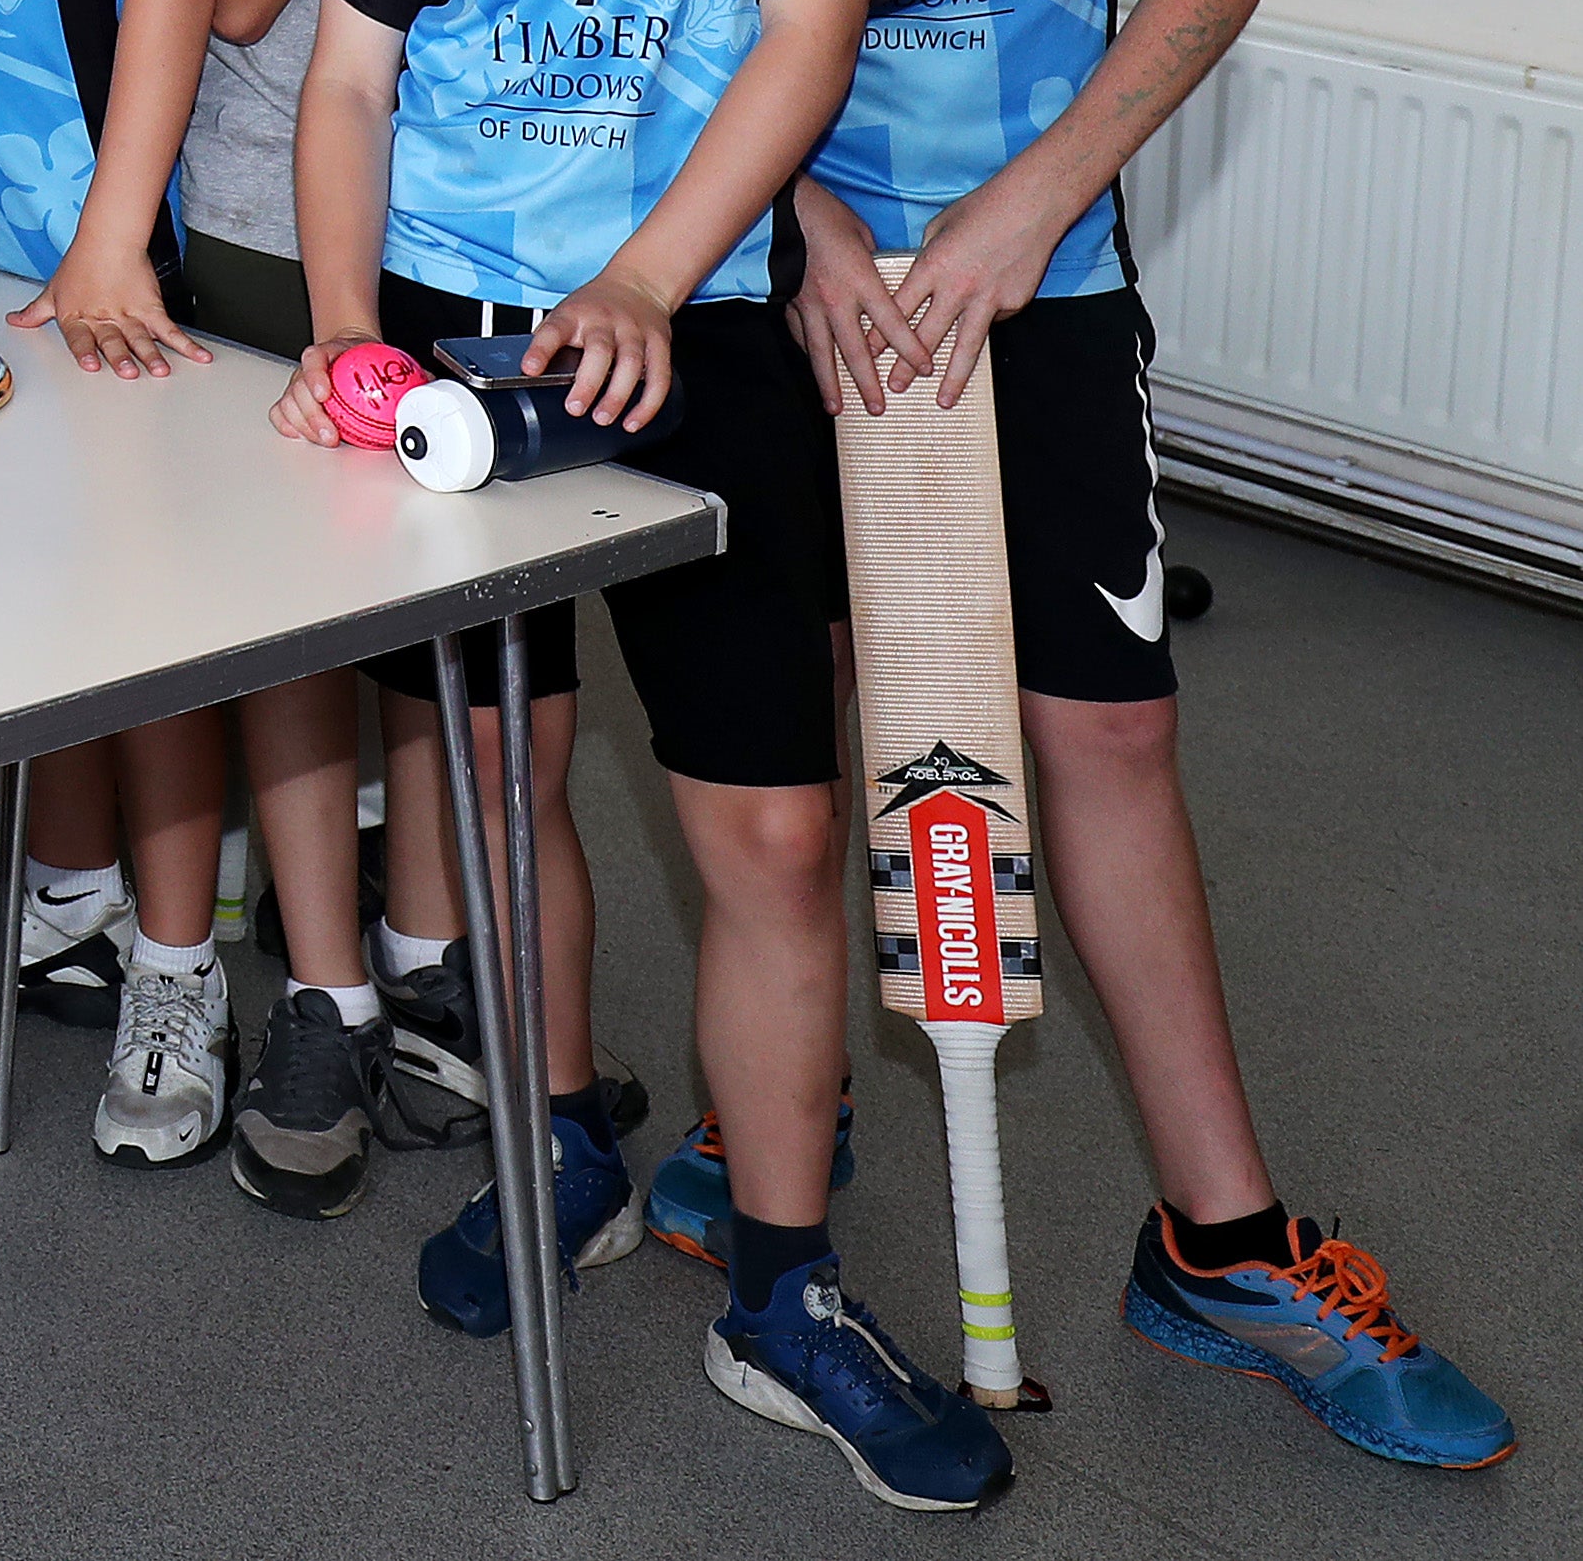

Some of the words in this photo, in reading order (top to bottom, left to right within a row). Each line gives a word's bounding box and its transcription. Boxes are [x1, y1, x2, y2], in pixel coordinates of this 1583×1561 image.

[864, 26, 986, 51] DULWICH
[478, 117, 511, 141] OF
[928, 822, 984, 1008] GRAY-NICOLLS
